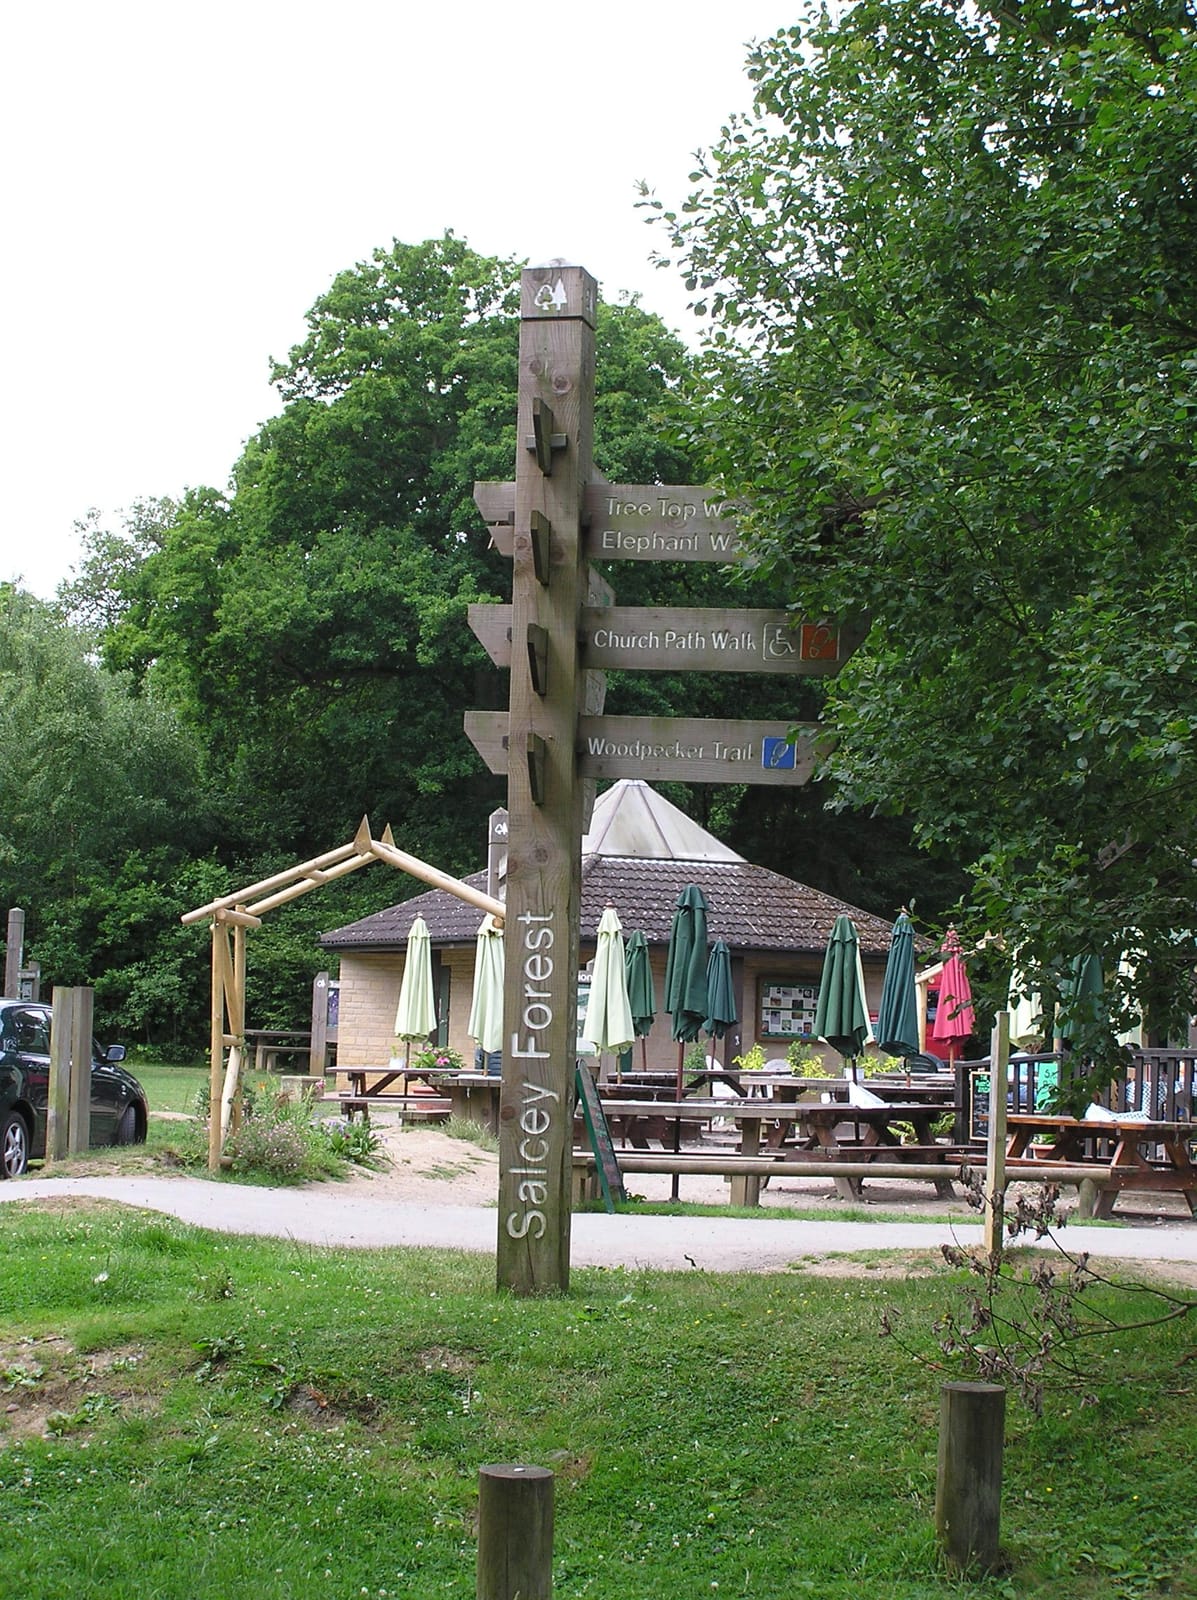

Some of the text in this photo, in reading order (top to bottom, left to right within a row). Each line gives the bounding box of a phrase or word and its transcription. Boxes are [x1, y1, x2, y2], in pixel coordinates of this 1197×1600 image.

[605, 497, 652, 516] Tree
[657, 498, 697, 520] Top
[602, 530, 700, 553] Elephant
[594, 629, 757, 651] Church Path Walk
[588, 737, 753, 761] Woodpecker Trail
[506, 910, 560, 1240] Salcey Forest
